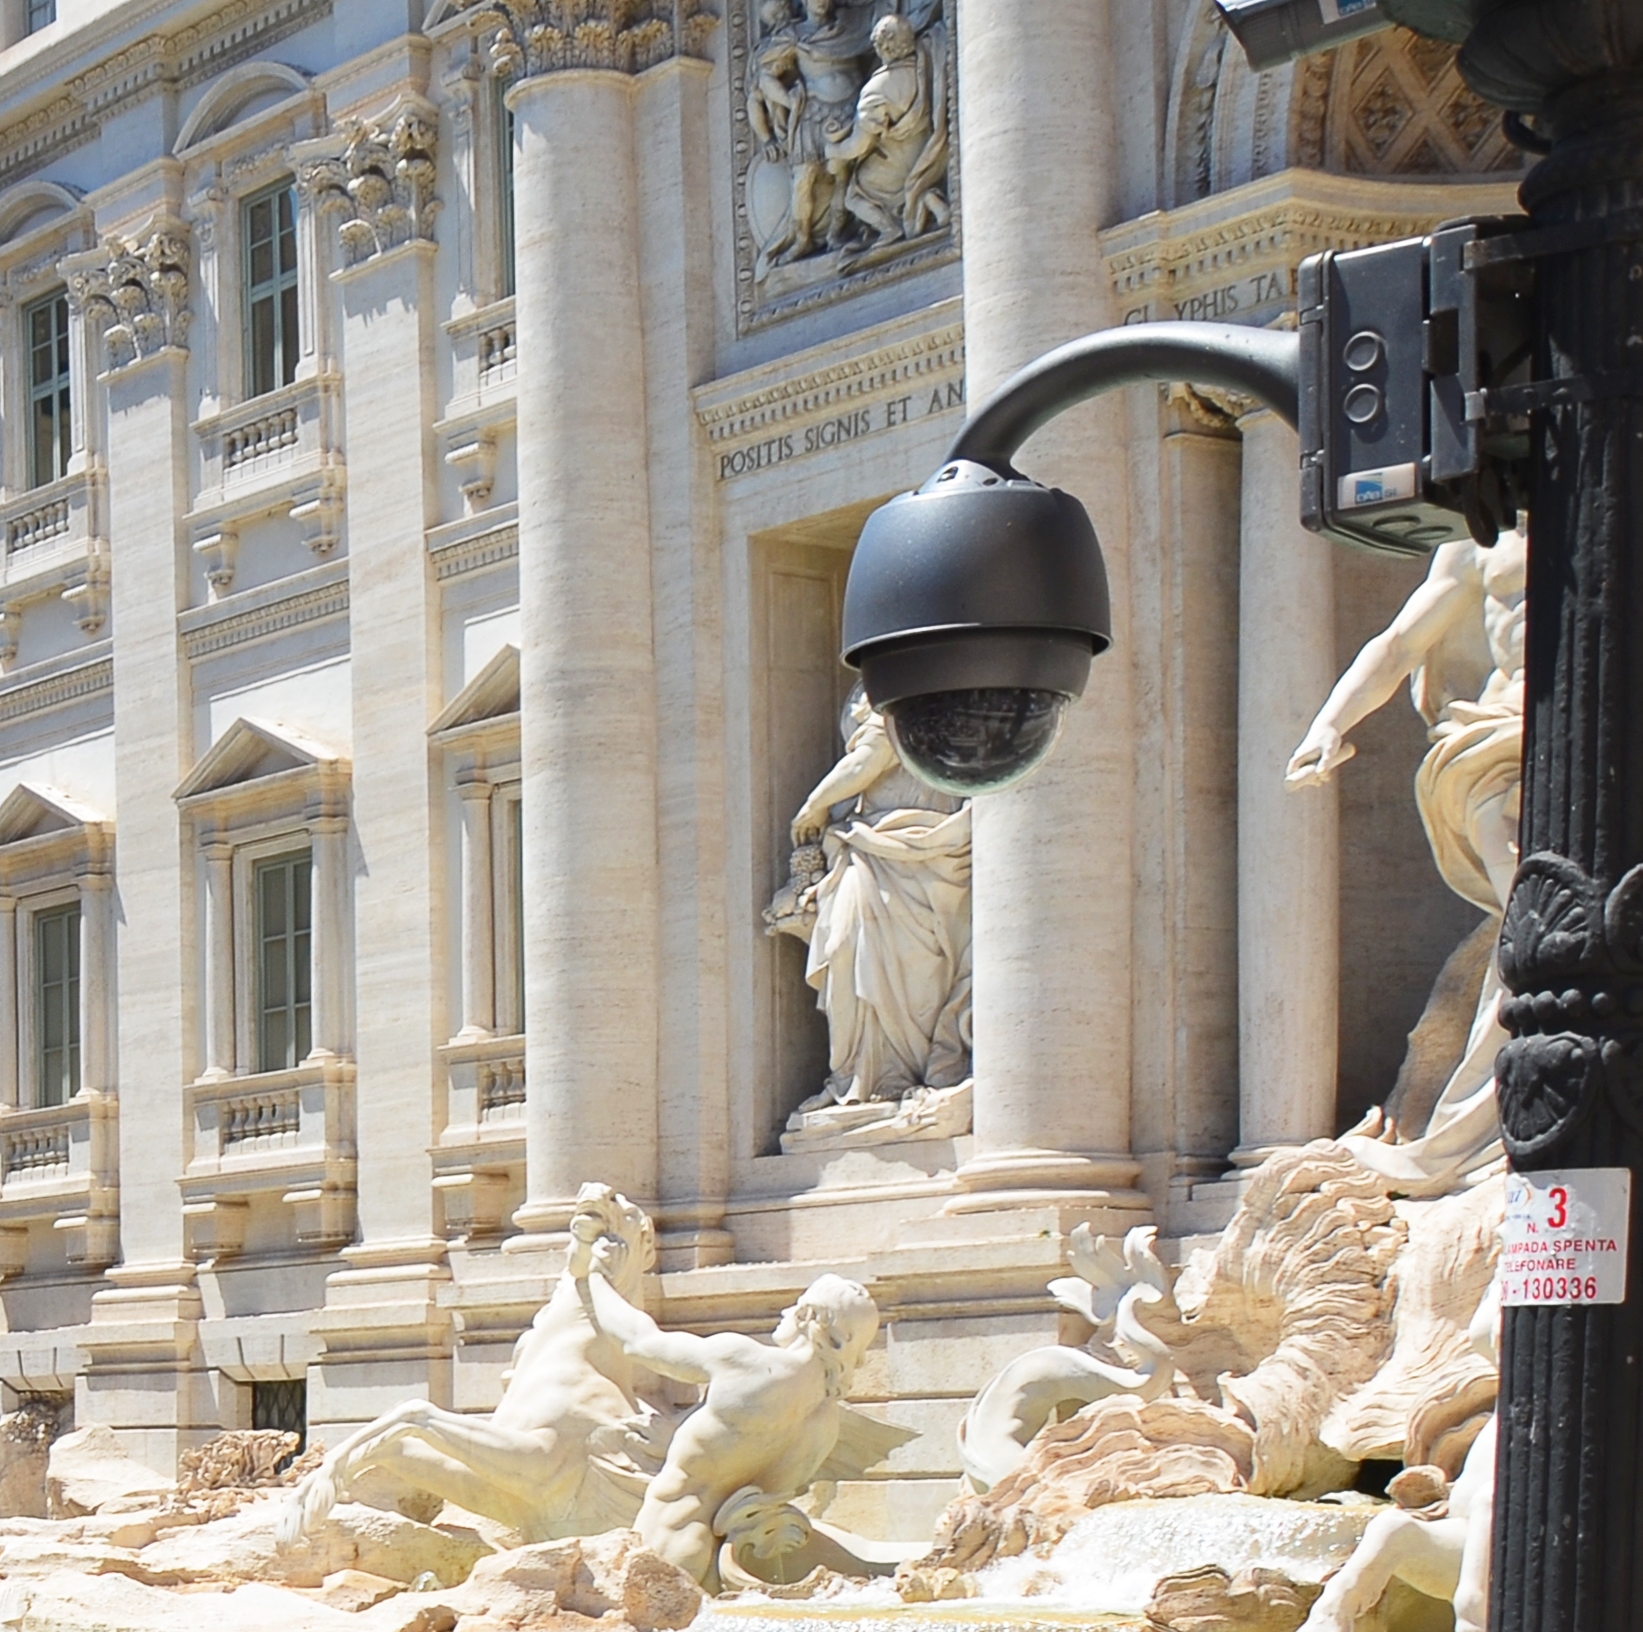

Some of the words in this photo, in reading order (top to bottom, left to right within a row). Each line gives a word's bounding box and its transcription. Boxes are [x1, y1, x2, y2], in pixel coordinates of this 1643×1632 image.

[719, 434, 794, 479] POSITIS
[804, 409, 870, 451] SIGNIS
[887, 396, 912, 428] ET
[1526, 1223, 1540, 1234] N.
[1547, 1187, 1568, 1229] 3
[1553, 1239, 1618, 1252] SPENTA
